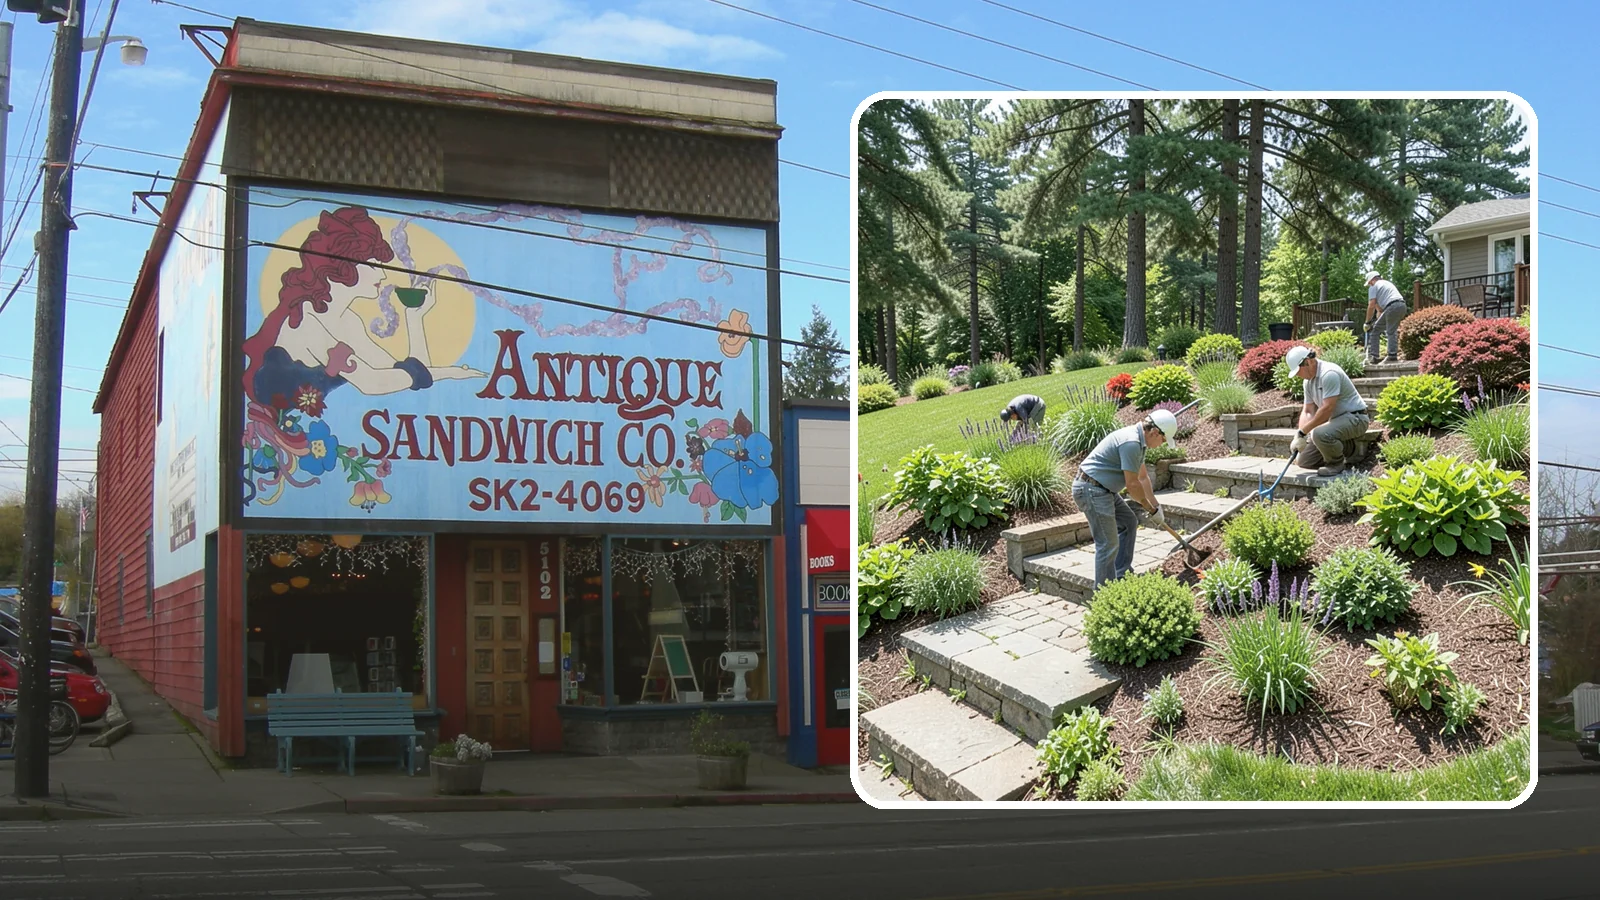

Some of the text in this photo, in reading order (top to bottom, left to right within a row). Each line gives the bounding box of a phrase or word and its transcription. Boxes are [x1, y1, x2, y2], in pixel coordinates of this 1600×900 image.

[476, 328, 723, 420] ANTIQUE
[362, 408, 685, 469] SANDWICH CO.
[468, 478, 645, 513] SK2-4069
[540, 542, 552, 600] 5102
[809, 555, 835, 569] BOOKS
